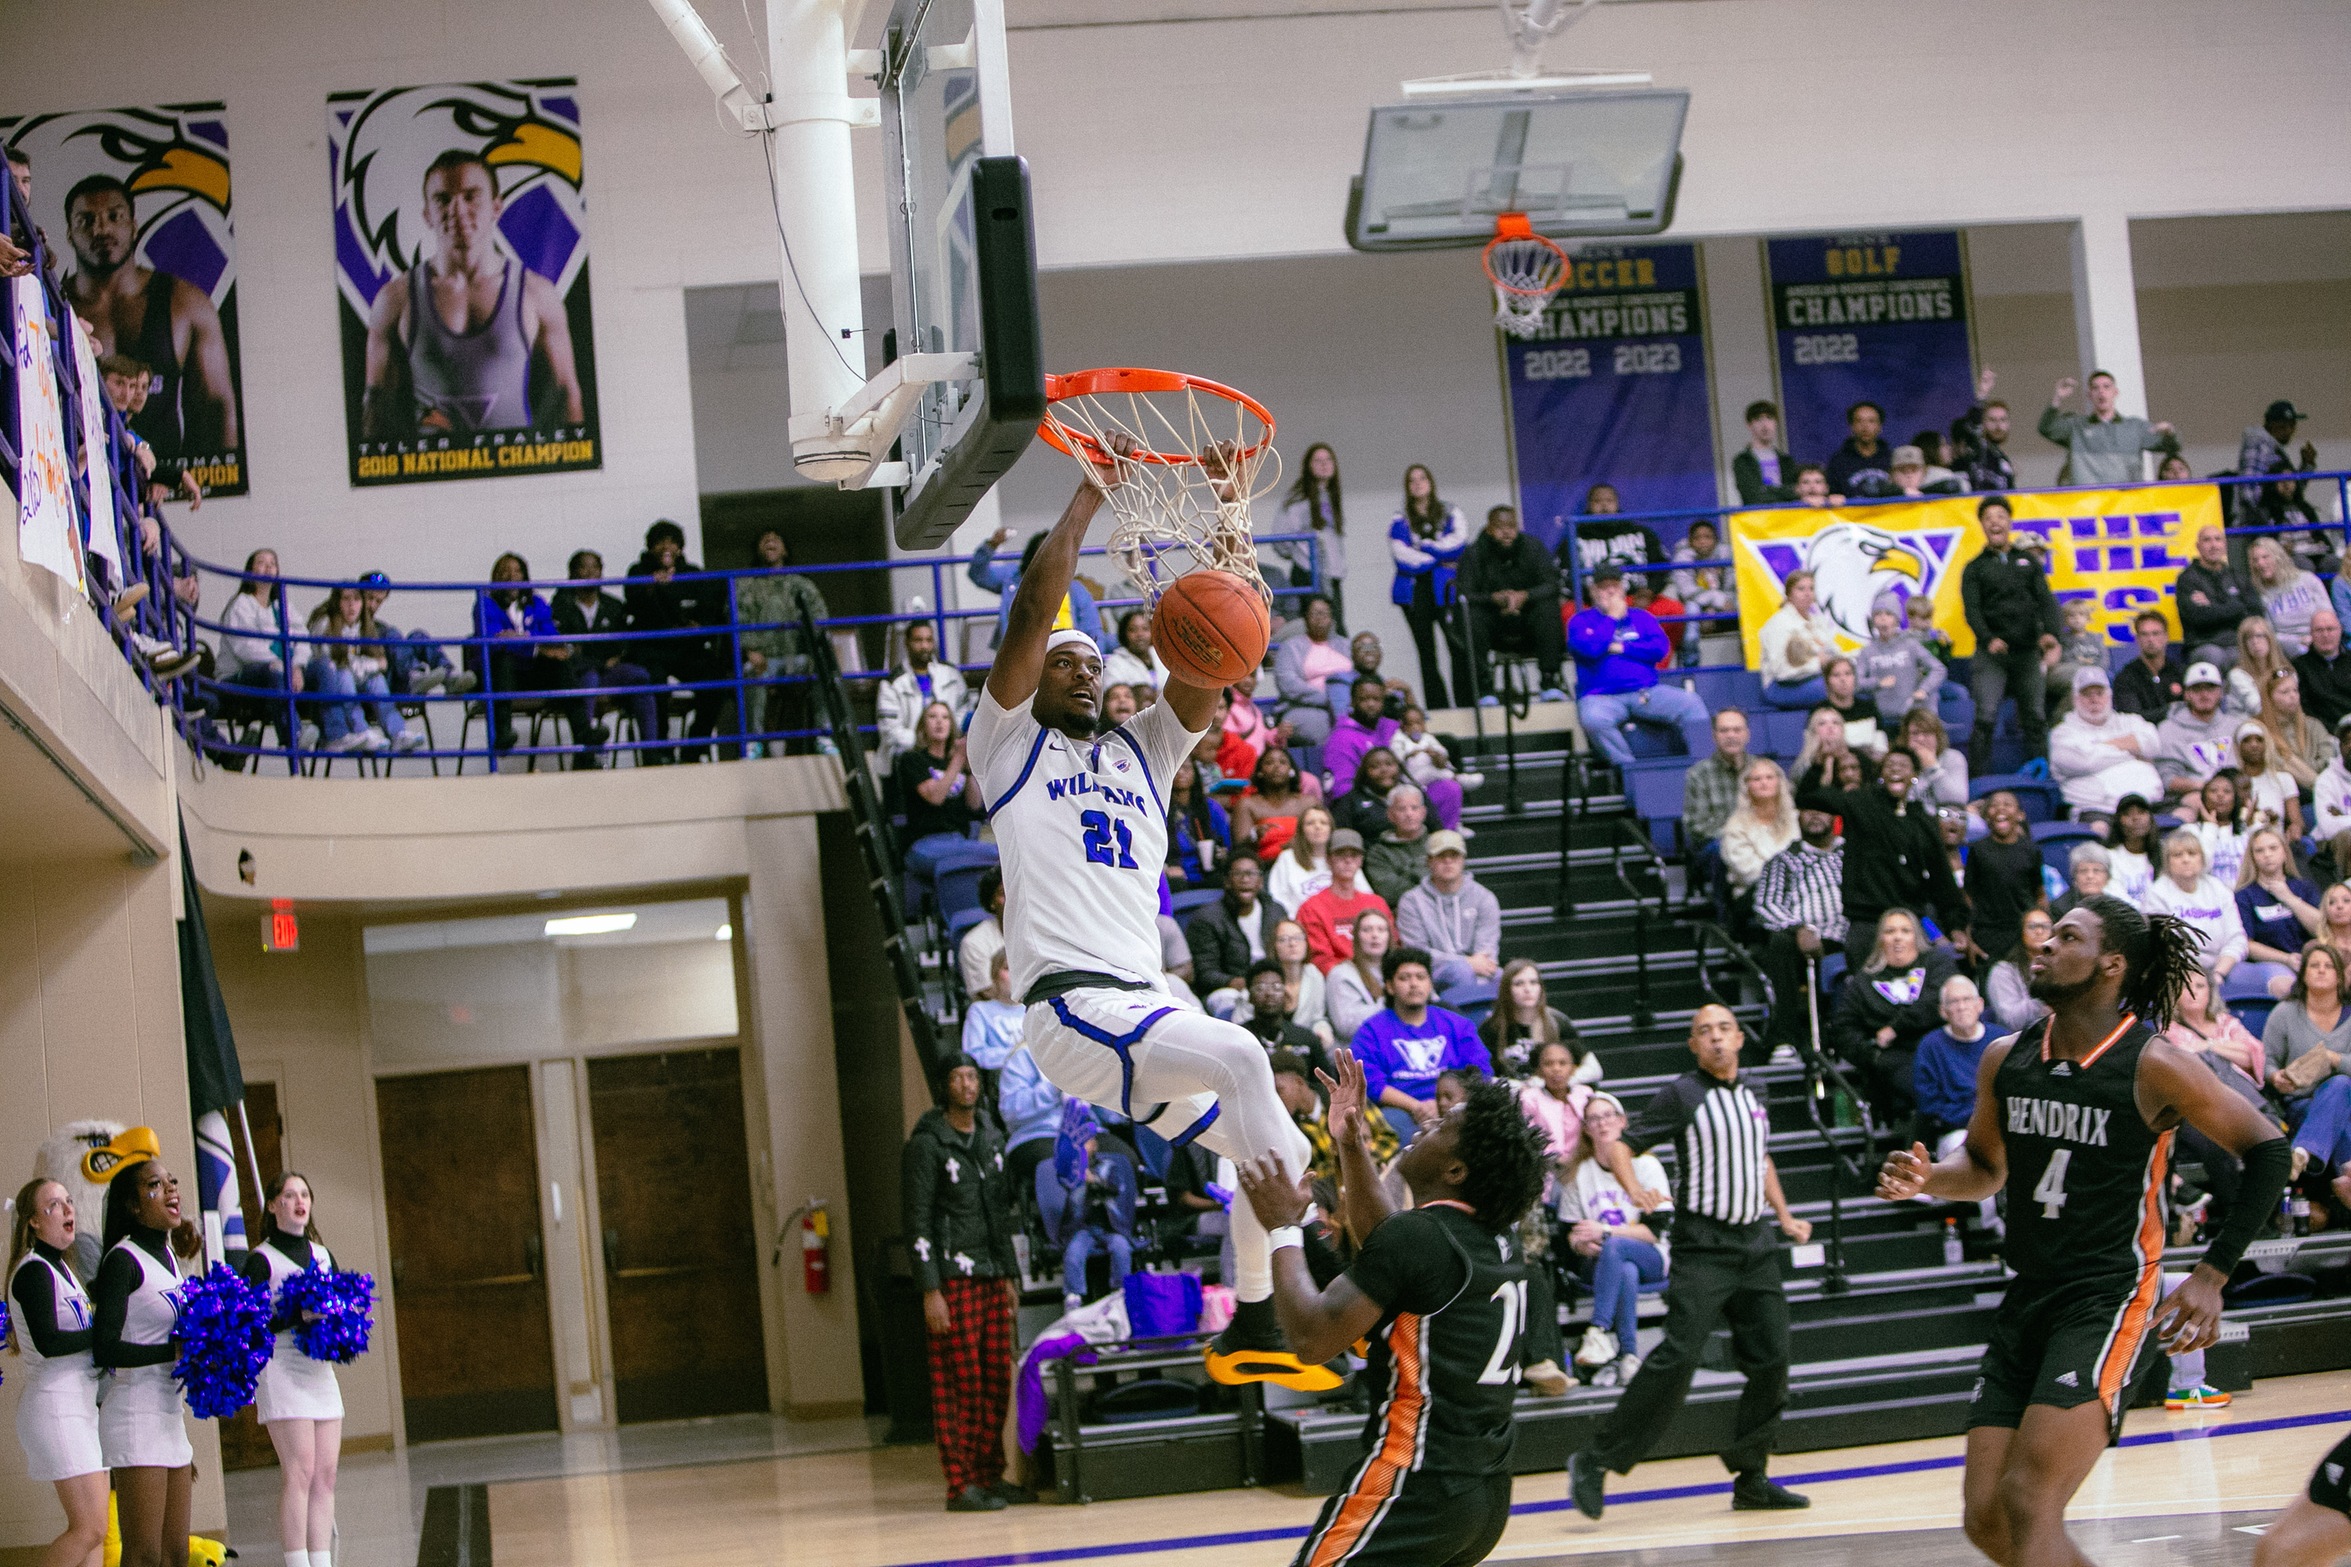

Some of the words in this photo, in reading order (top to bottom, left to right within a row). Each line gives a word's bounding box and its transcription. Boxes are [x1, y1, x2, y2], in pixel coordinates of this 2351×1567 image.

[1826, 247, 1899, 276] GOLF
[1537, 304, 1688, 340] HAMPIONS
[1787, 292, 1952, 326] CHAMPIONS
[1523, 347, 1592, 380] 2022
[1613, 342, 1682, 375] 2023
[1794, 333, 1860, 365] 2022
[357, 454, 399, 479] 2018
[403, 446, 496, 475] NATIONAL
[497, 439, 594, 468] CHAMPION
[358, 437, 450, 456] TYLER
[474, 426, 588, 448] FRALEY
[1081, 809, 1139, 870] 21
[273, 914, 295, 949] EXIT
[2006, 1096, 2112, 1147] HENDRIX
[2032, 1148, 2073, 1219] 4
